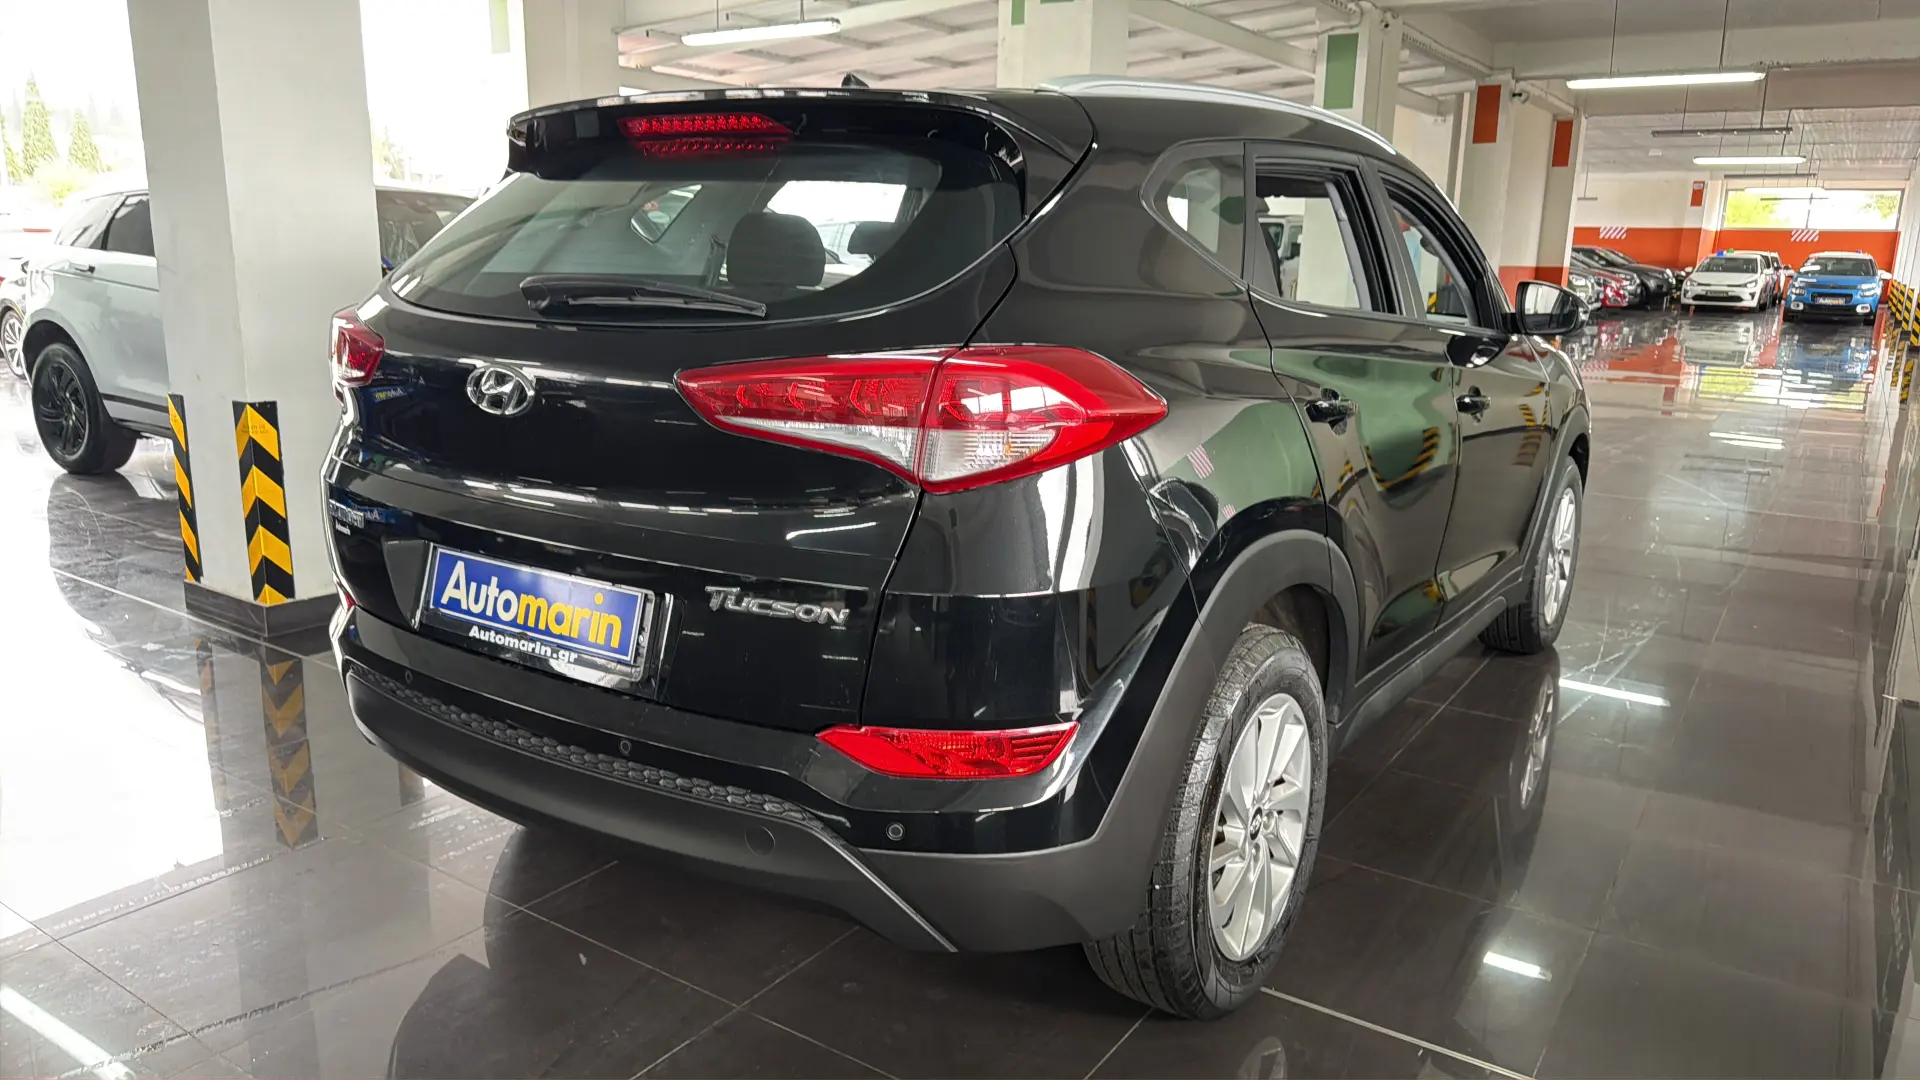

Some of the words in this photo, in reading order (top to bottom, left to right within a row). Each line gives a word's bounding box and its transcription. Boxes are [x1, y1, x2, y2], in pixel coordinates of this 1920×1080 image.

[440, 560, 622, 649] Automarin
[705, 585, 850, 625] TUCSON
[468, 625, 578, 663] Automarin.gr
